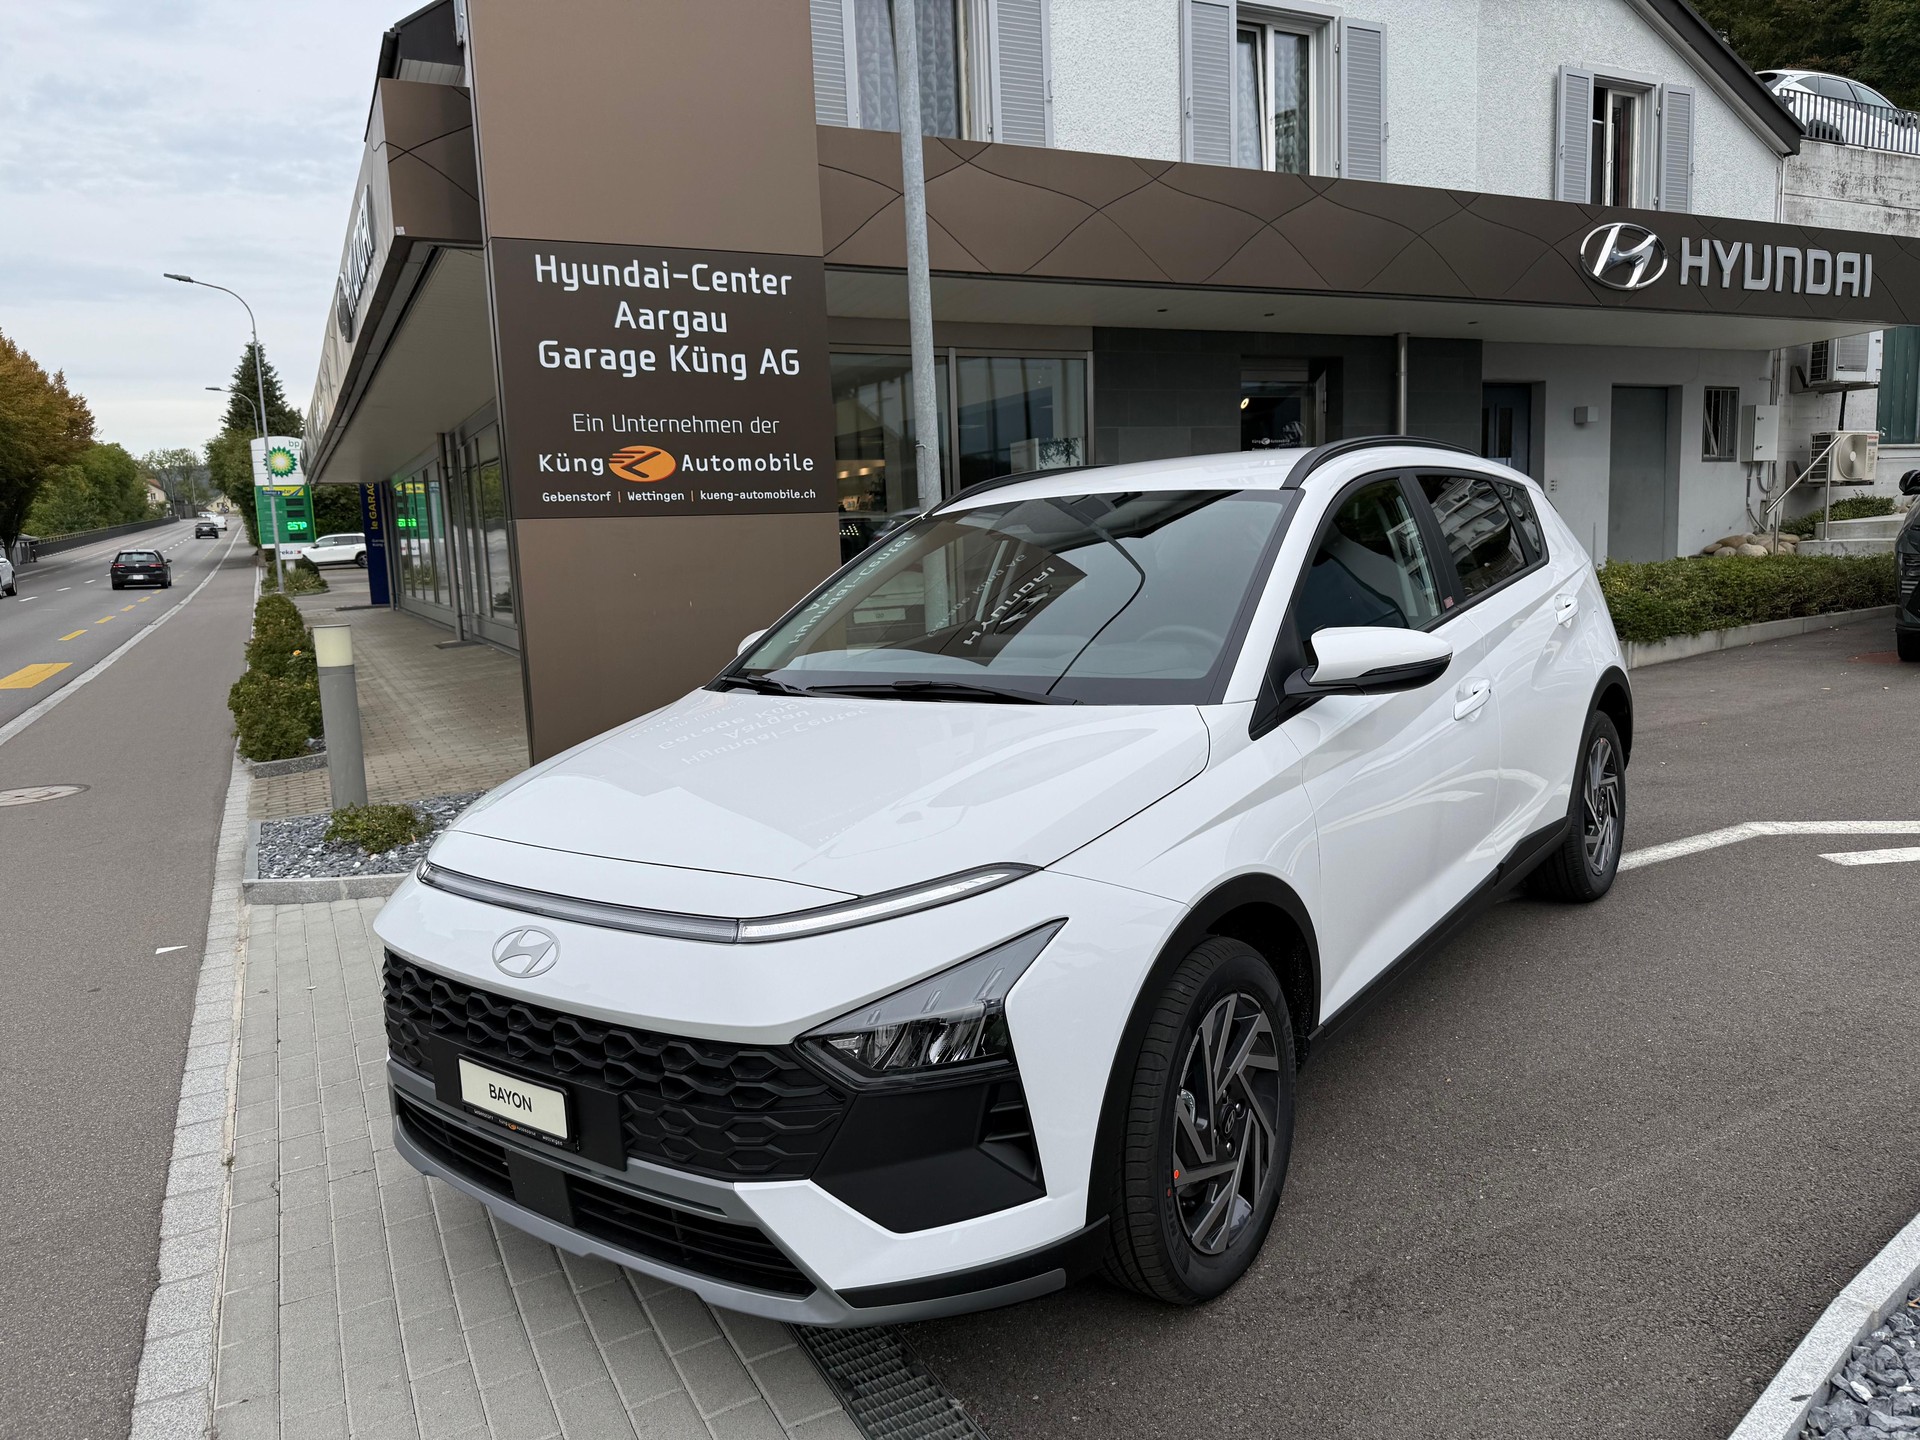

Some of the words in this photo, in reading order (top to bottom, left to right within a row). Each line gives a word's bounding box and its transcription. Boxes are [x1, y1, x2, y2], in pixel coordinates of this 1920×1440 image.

[535, 254, 792, 295] Hyundai-Center
[1680, 237, 1873, 297] HYUNDAI
[614, 301, 727, 338] Aargau
[538, 340, 656, 378] Garage
[669, 344, 747, 381] Küng
[760, 348, 800, 376] AG
[572, 413, 604, 432] Ein
[611, 414, 743, 434] Unternehmen
[750, 416, 780, 434] der
[288, 440, 300, 448] bp
[538, 453, 605, 476] Küng
[681, 452, 814, 472] Automobile
[542, 490, 612, 502] Gebenstorf
[627, 490, 685, 502] Wettingen
[700, 488, 816, 501] kueng-automobile.ch
[489, 1084, 532, 1112] BAYON
